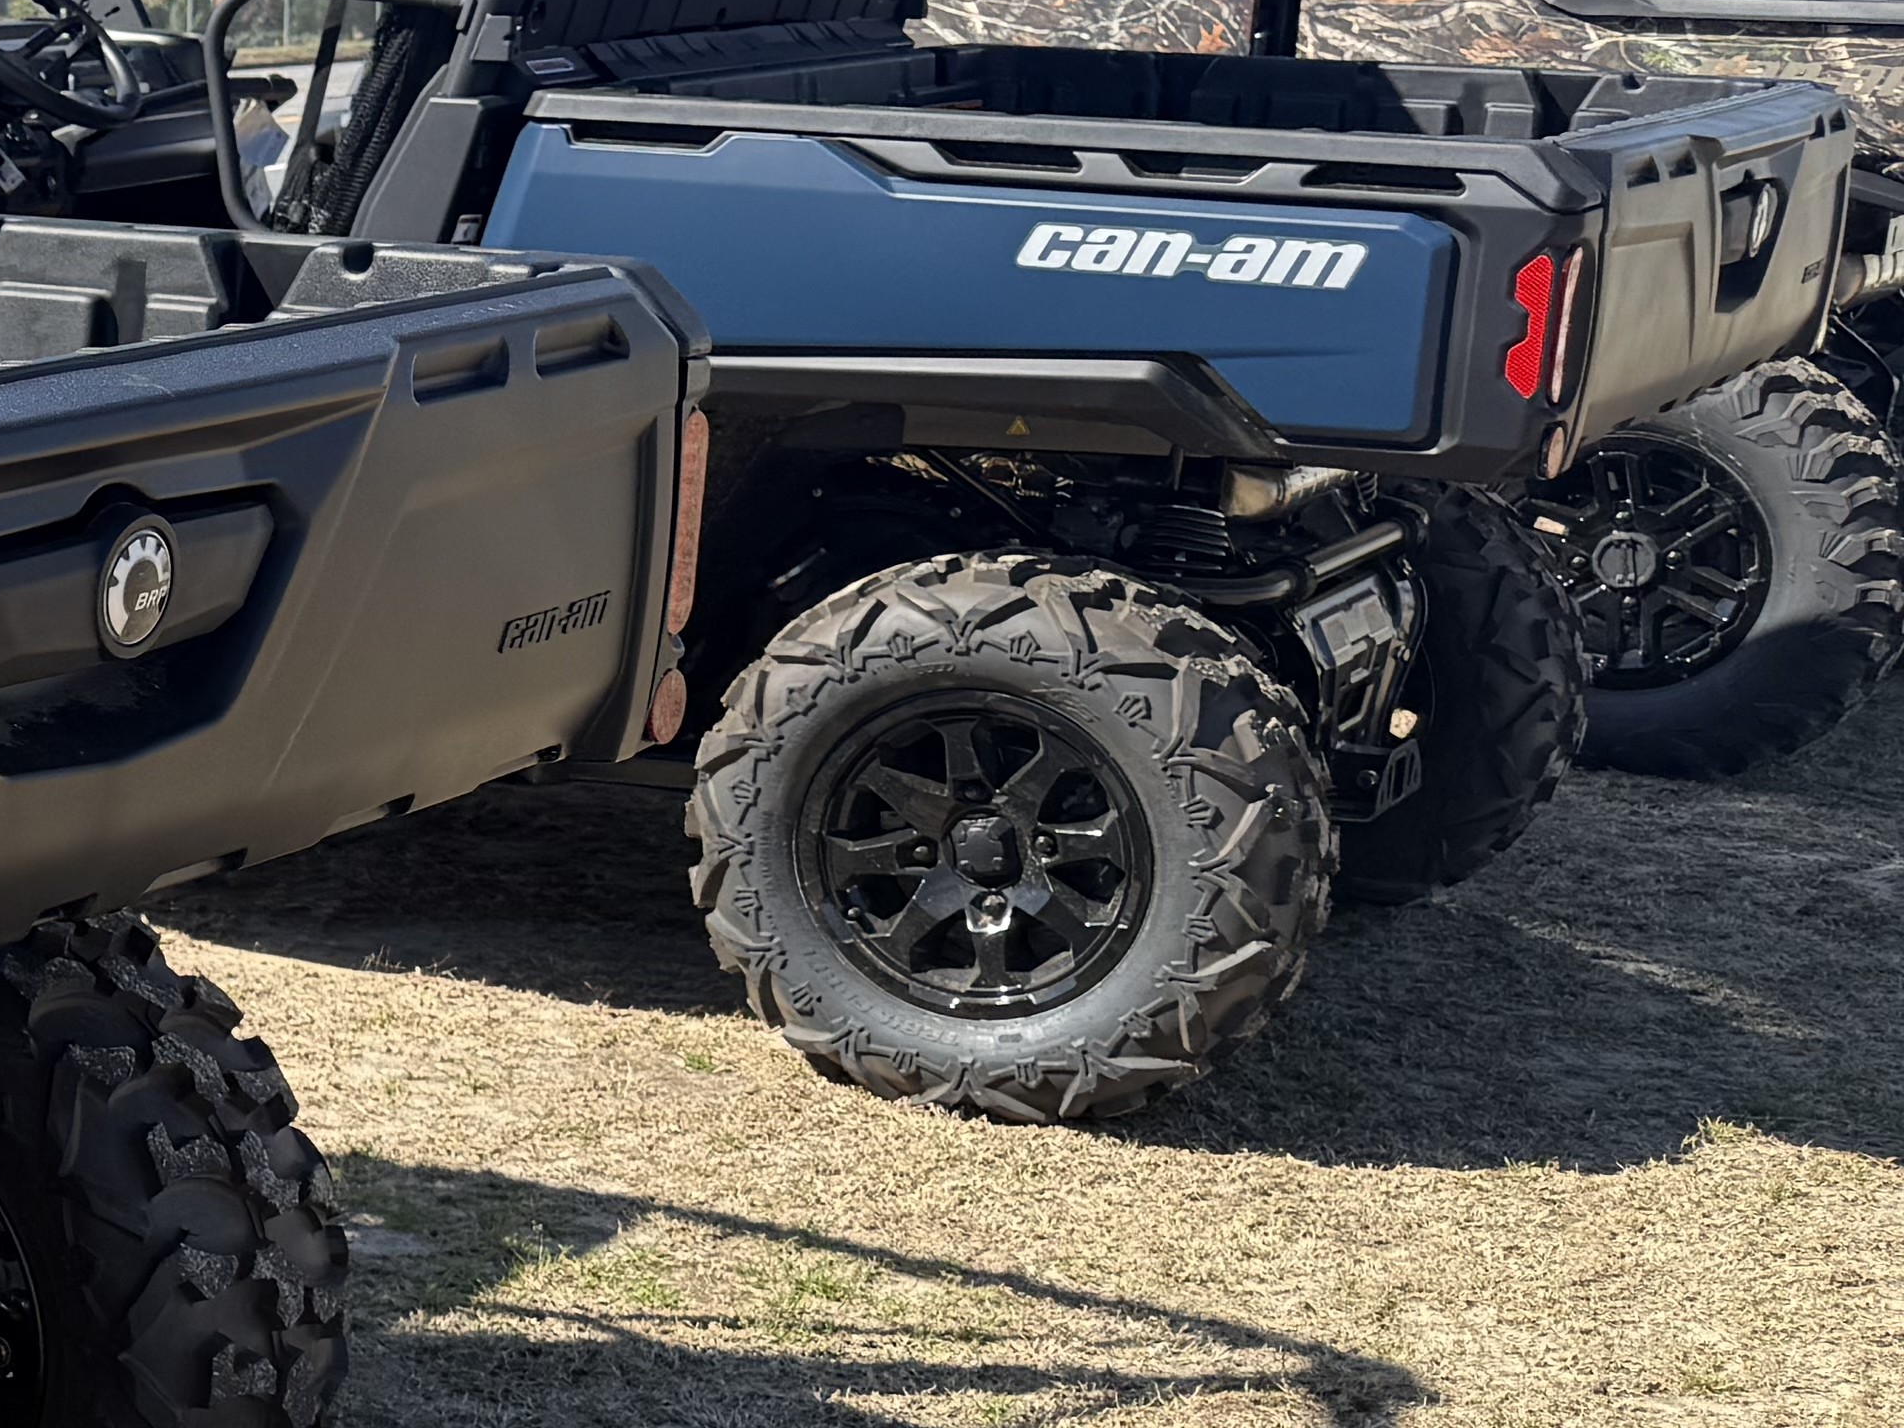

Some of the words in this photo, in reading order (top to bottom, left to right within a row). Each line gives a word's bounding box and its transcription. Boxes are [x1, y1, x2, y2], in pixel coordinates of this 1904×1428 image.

[1017, 224, 1368, 289] can-am
[135, 585, 168, 611] BRP
[497, 590, 612, 653] can-am
